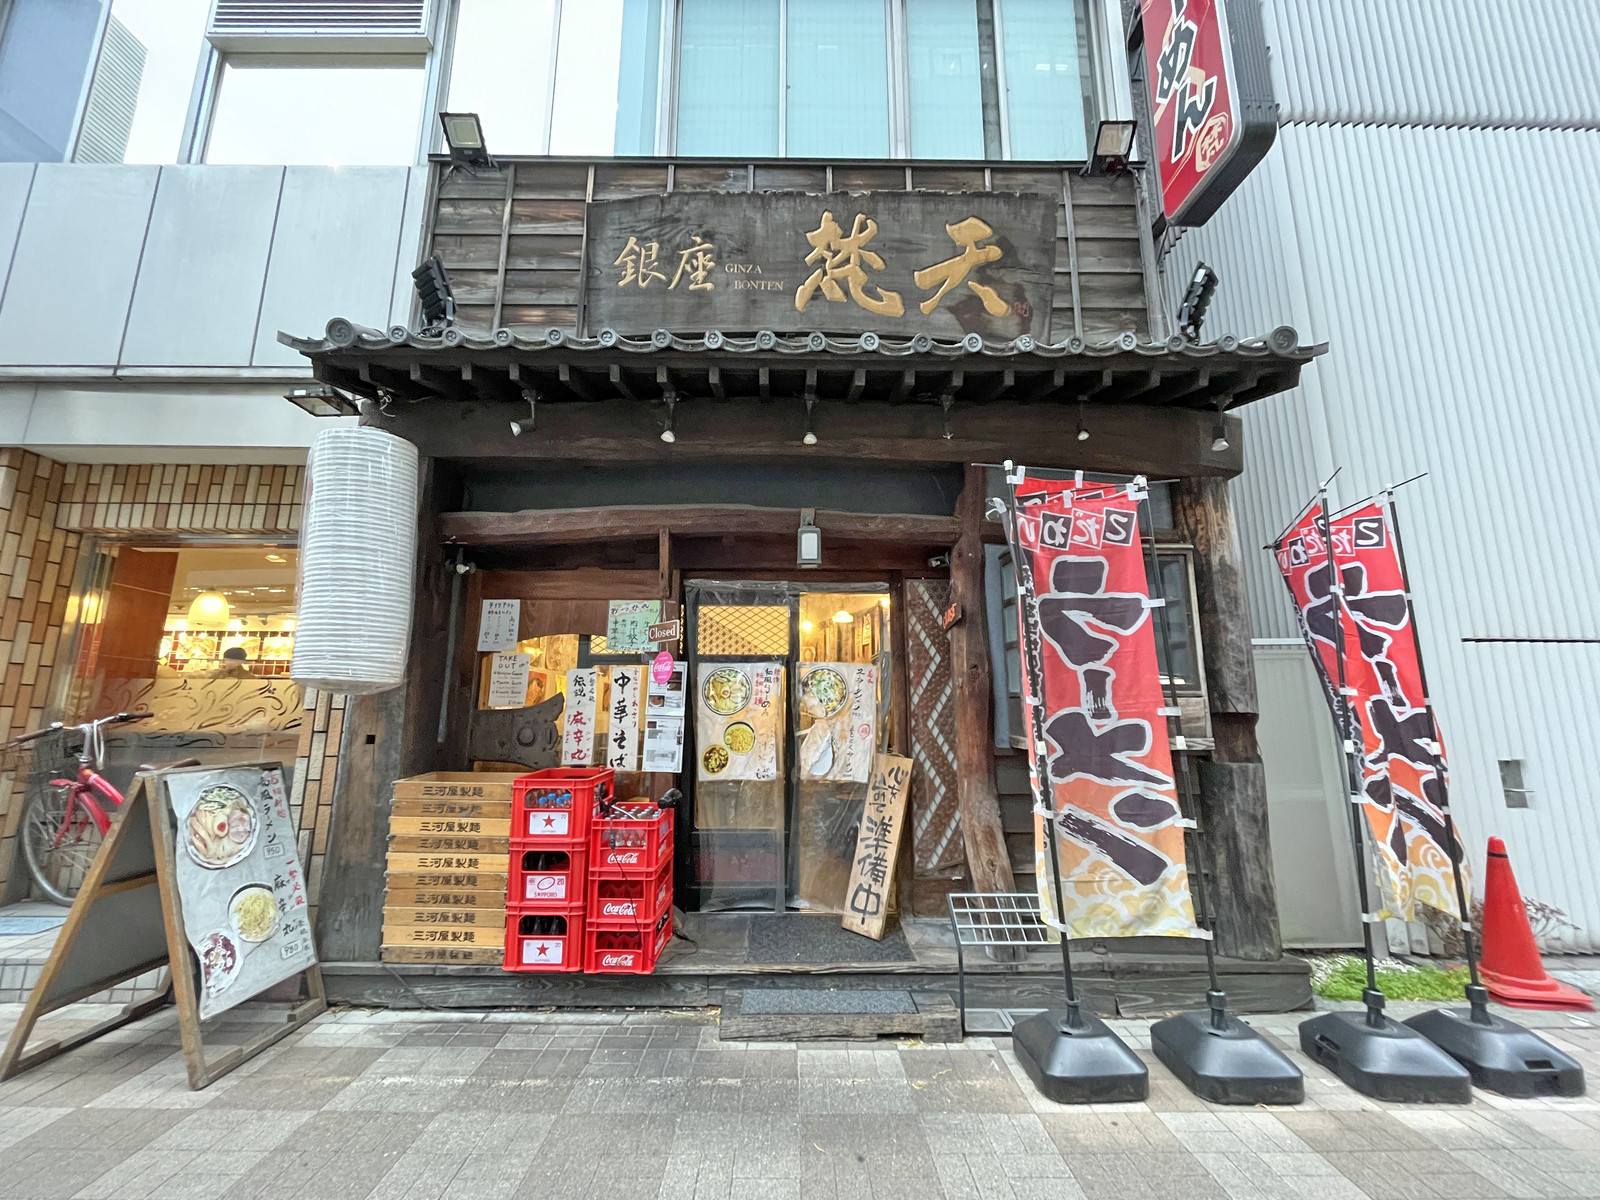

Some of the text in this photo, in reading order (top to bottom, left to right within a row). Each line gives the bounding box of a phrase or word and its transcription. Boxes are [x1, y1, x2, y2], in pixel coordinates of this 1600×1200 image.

[613, 235, 716, 292] 銀座
[724, 263, 763, 275] GINZA
[794, 208, 1013, 319] 梵天
[733, 279, 785, 292] BONTEN
[649, 625, 677, 640] Closed
[609, 672, 631, 768] 中華そば
[422, 786, 484, 798] 三河屋製麺
[419, 821, 481, 833] 三河屋製麺
[418, 839, 480, 850] 三河屋製麺
[417, 857, 480, 869] 三河屋製麺
[850, 815, 893, 925] 準備中
[415, 875, 478, 887] 三河屋製麺
[556, 877, 565, 886] 20
[414, 893, 477, 905] 三河屋製麺
[413, 911, 476, 924] 三河屋製麺
[413, 930, 475, 943] 三河屋製麺
